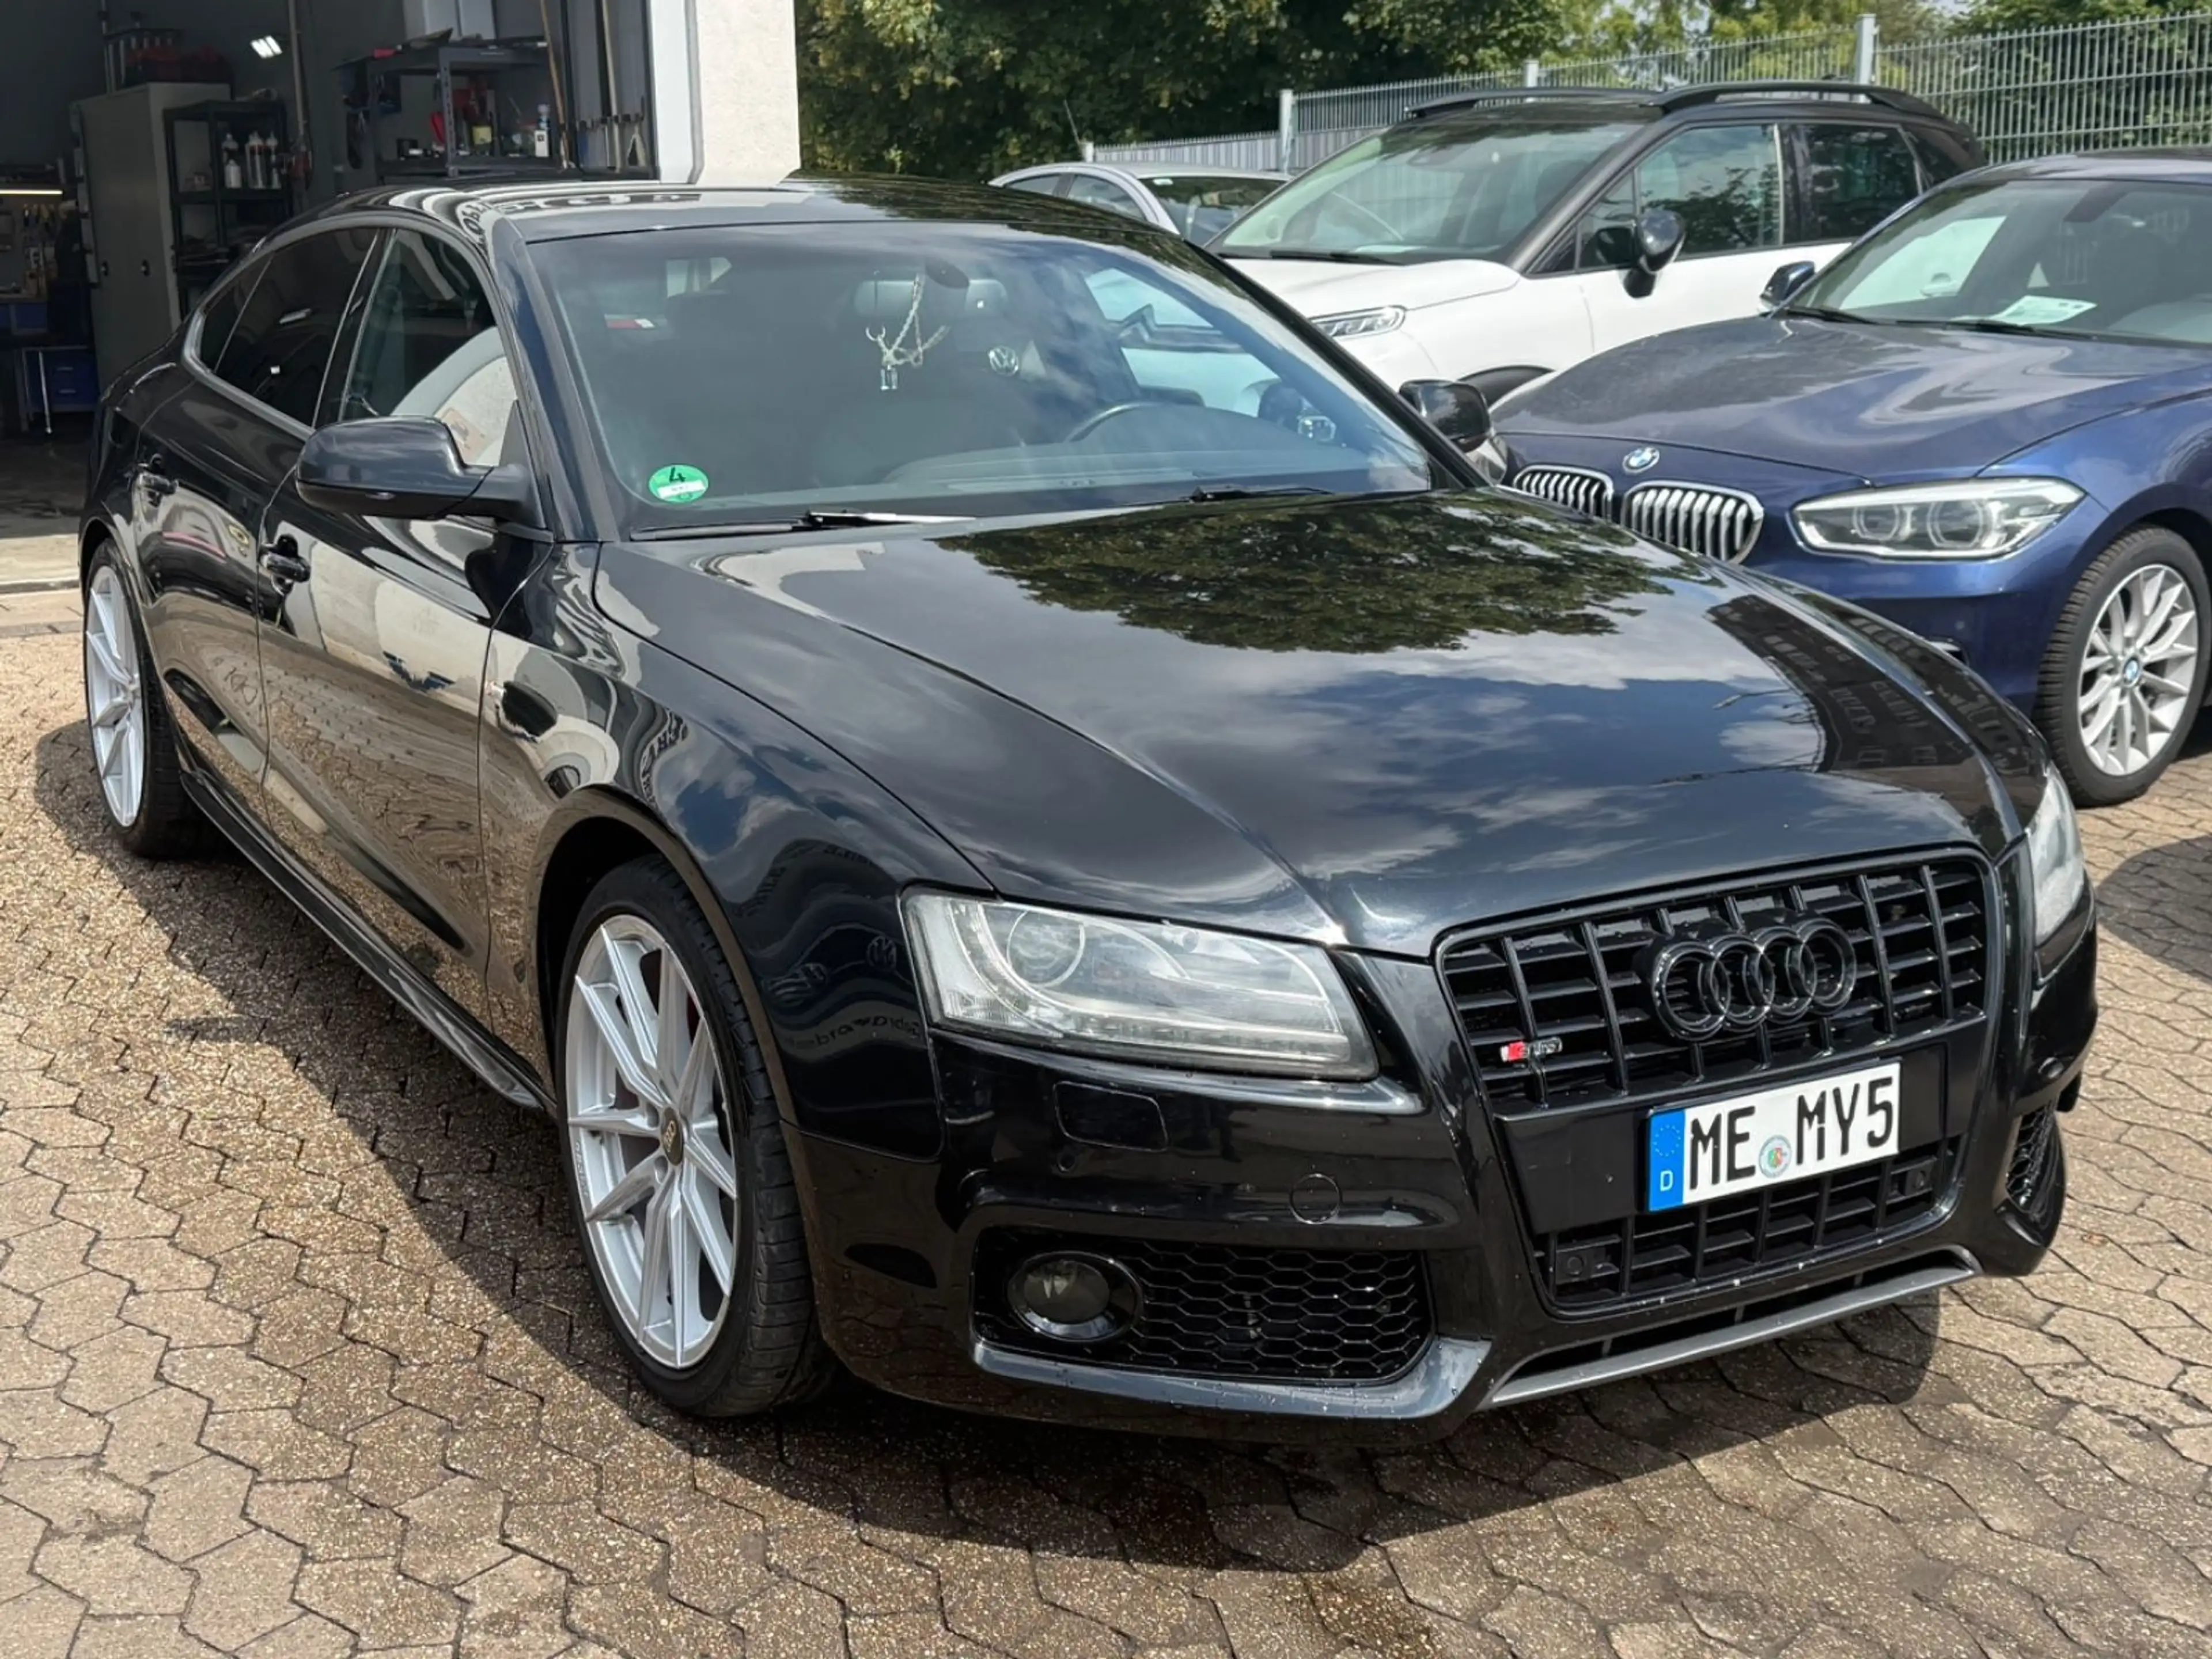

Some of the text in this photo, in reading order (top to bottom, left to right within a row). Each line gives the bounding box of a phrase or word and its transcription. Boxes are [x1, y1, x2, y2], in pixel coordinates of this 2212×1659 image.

[669, 467, 687, 482] 4
[1690, 1076, 1893, 1190] ME MY5
[1660, 1170, 1673, 1192] D
